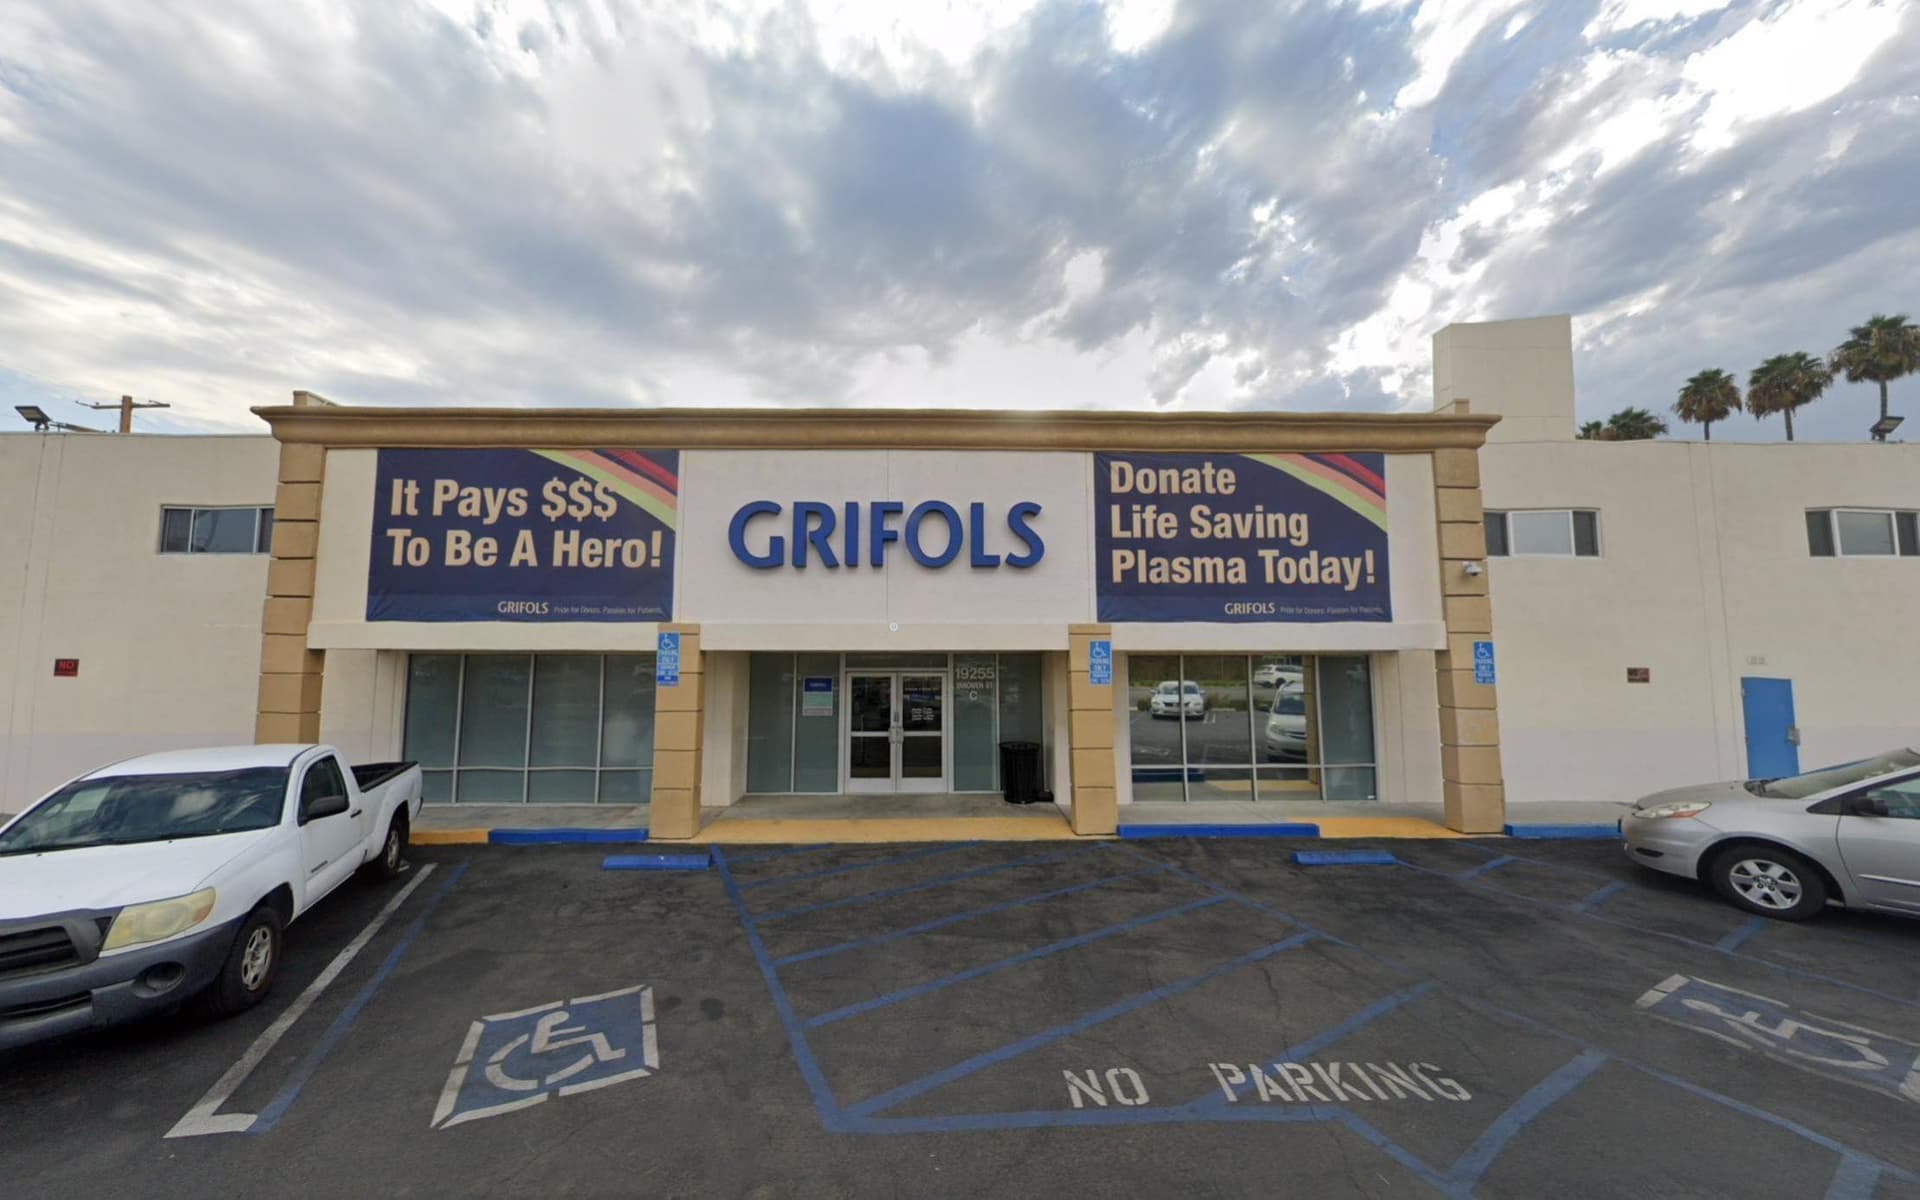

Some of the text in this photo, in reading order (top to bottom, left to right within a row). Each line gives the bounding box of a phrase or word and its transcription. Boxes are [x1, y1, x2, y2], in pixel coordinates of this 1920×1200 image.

[1109, 460, 1236, 495] Donate
[389, 476, 618, 526] It Pays $$$
[728, 500, 1045, 569] GRIFOLS
[1110, 504, 1309, 547] Life Saving
[386, 528, 663, 568] To Be A Hero!
[1111, 549, 1376, 592] Plasma Today!
[497, 600, 549, 615] GRIFOLS
[1224, 601, 1276, 616] GRIFOLS
[955, 666, 995, 680] 19255
[1062, 1061, 1473, 1109] NO PARKING
